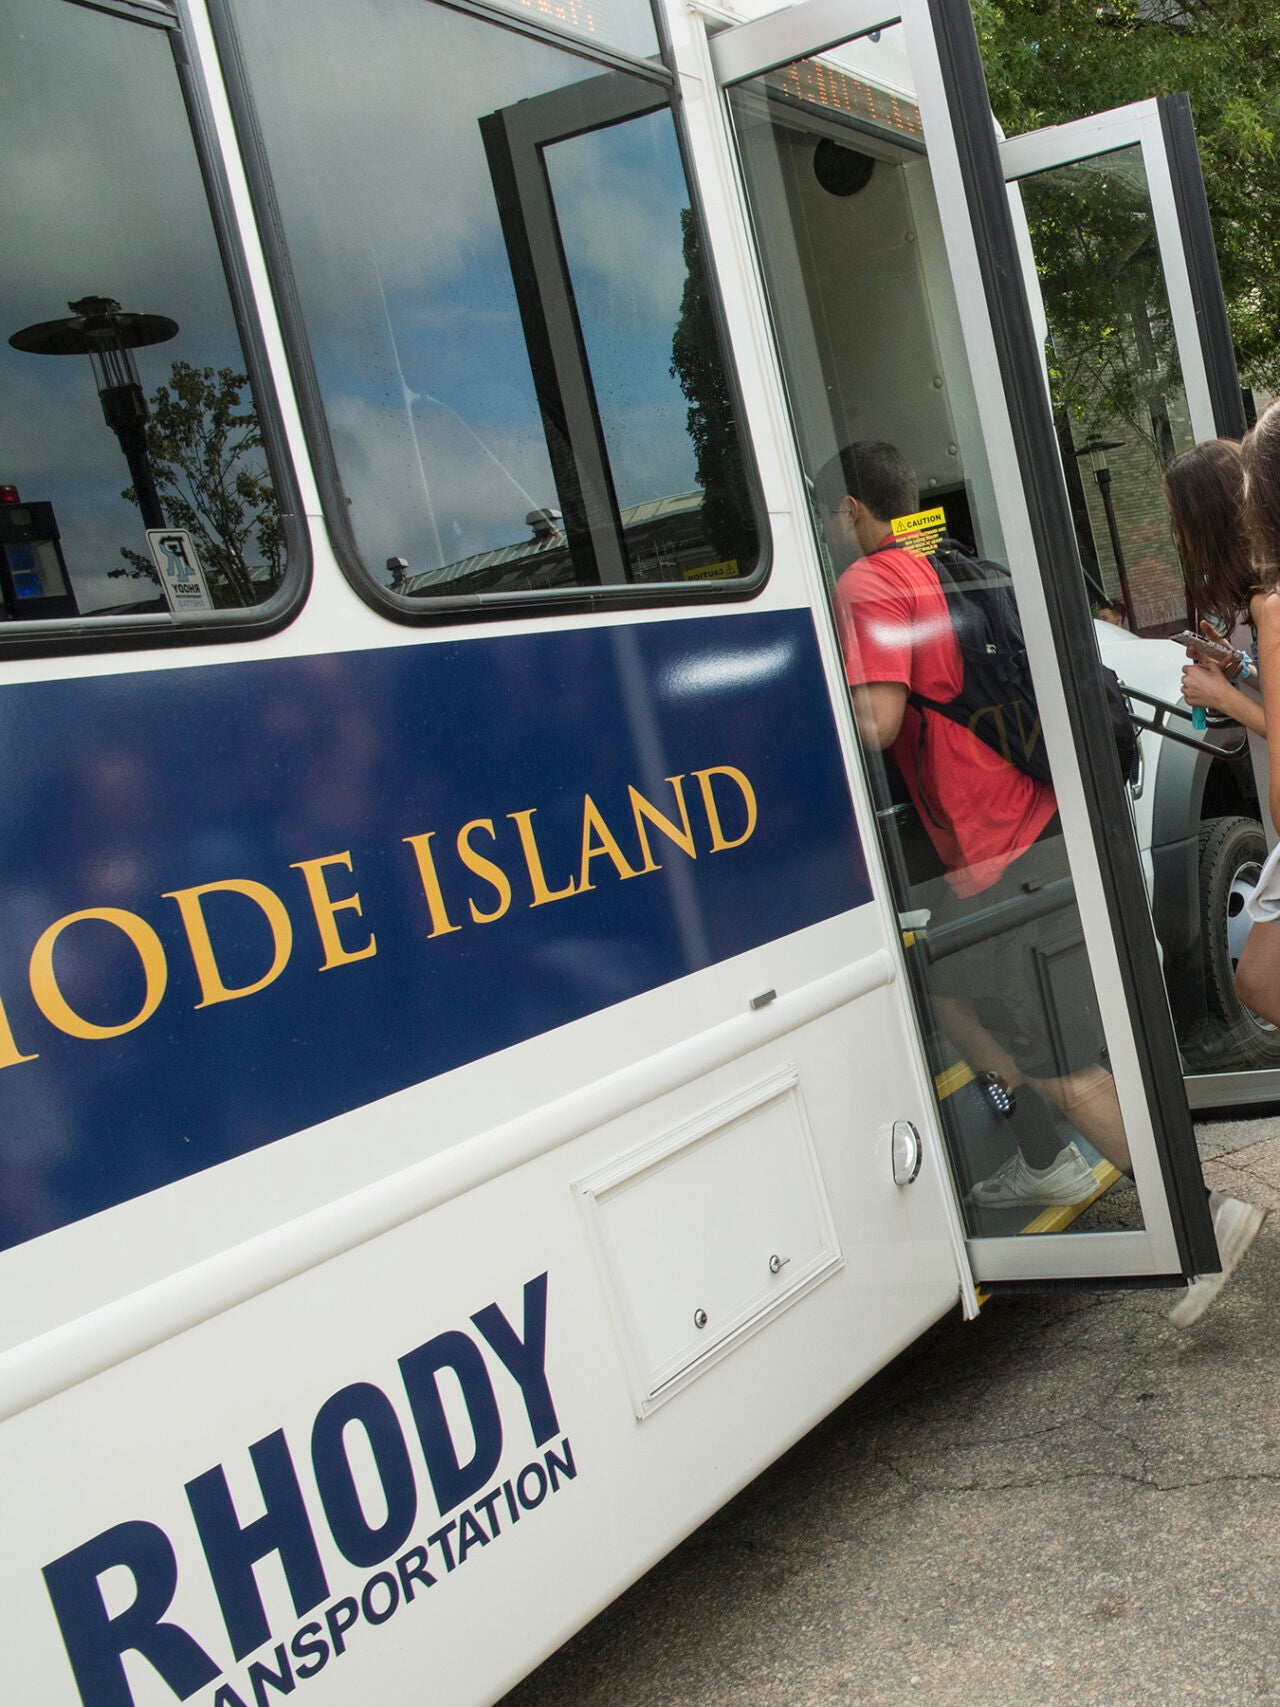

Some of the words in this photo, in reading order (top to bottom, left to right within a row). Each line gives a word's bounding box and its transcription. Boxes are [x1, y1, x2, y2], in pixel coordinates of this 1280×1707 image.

[907, 514, 941, 528] CAUTION
[403, 765, 757, 938] ISLAND
[41, 1270, 562, 1707] RHODY
